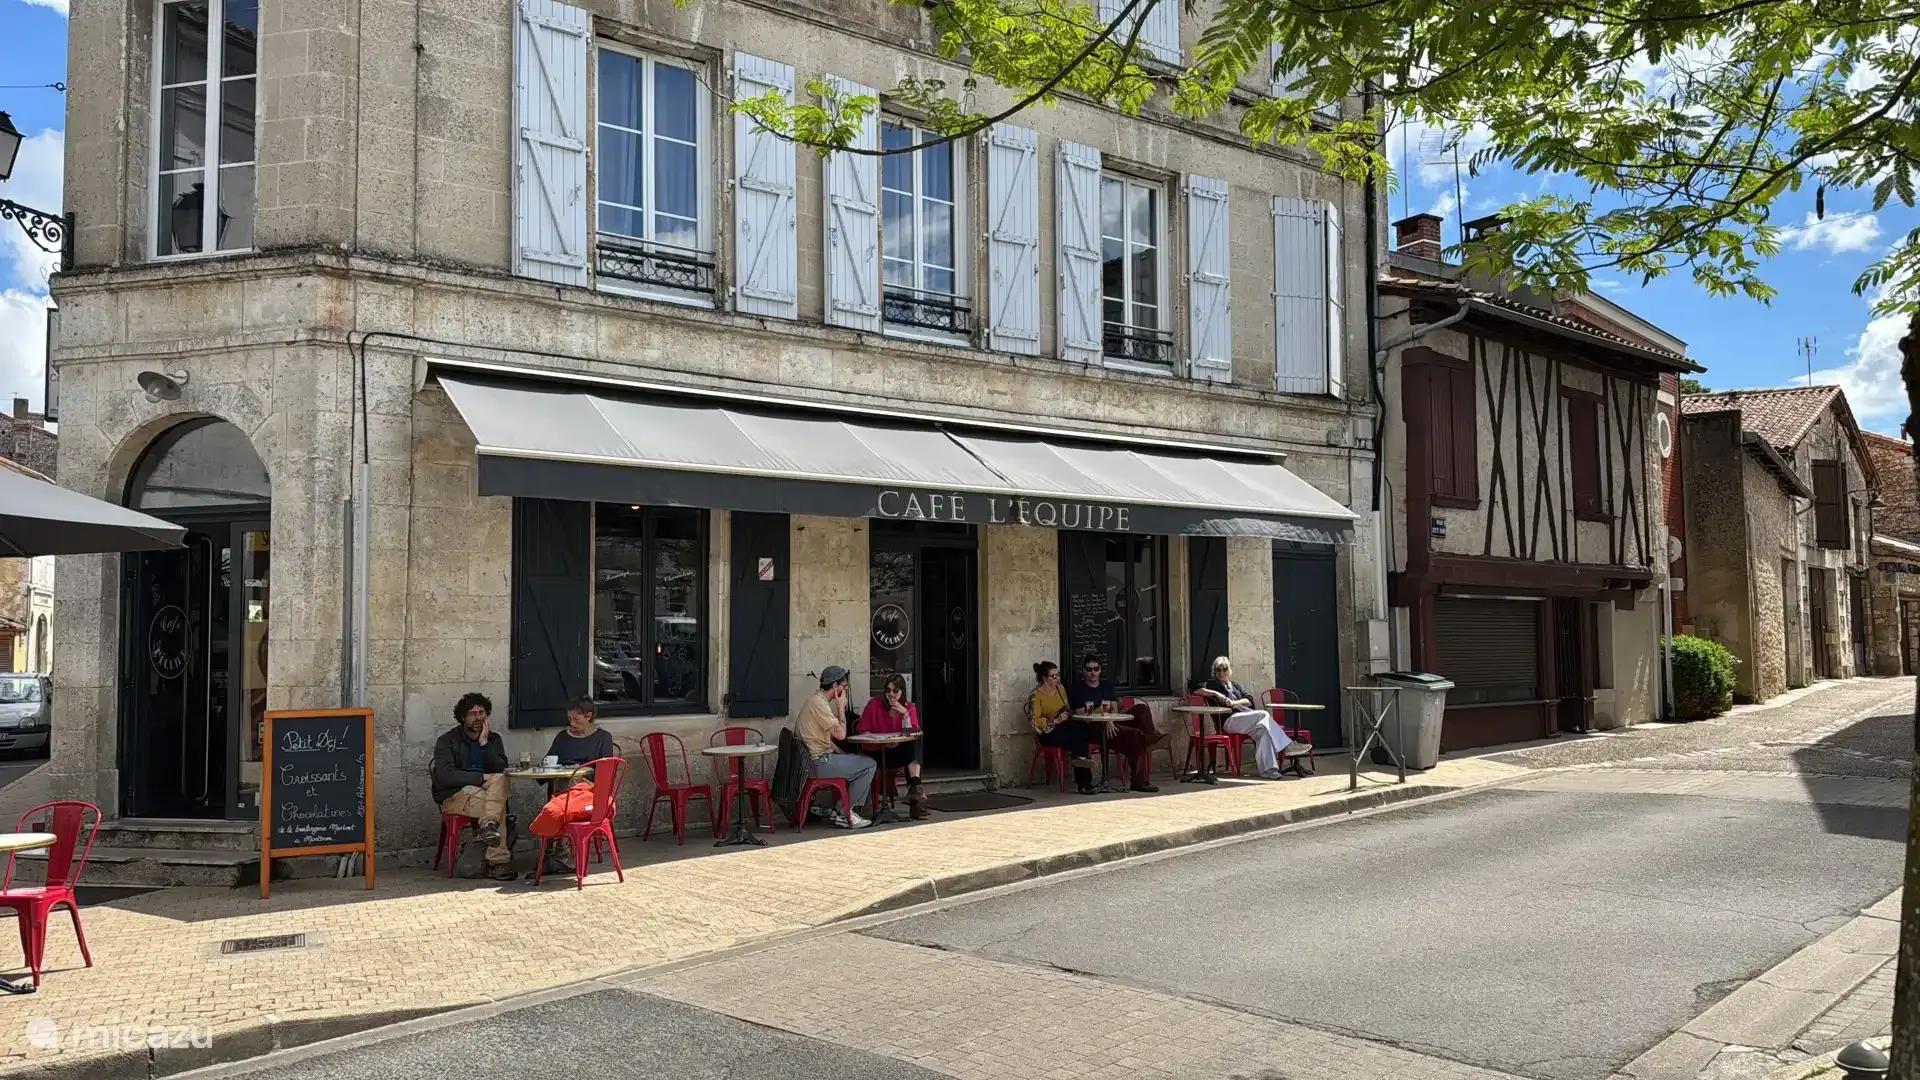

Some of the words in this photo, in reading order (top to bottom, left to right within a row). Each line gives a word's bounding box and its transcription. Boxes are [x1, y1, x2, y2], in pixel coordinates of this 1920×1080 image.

[877, 490, 967, 522] CAFÉ
[988, 497, 1131, 532] L'ÉQUIPE
[281, 730, 313, 752] Petit
[280, 764, 348, 786] Croissants
[306, 785, 319, 797] et
[281, 802, 352, 822] Chocolatines
